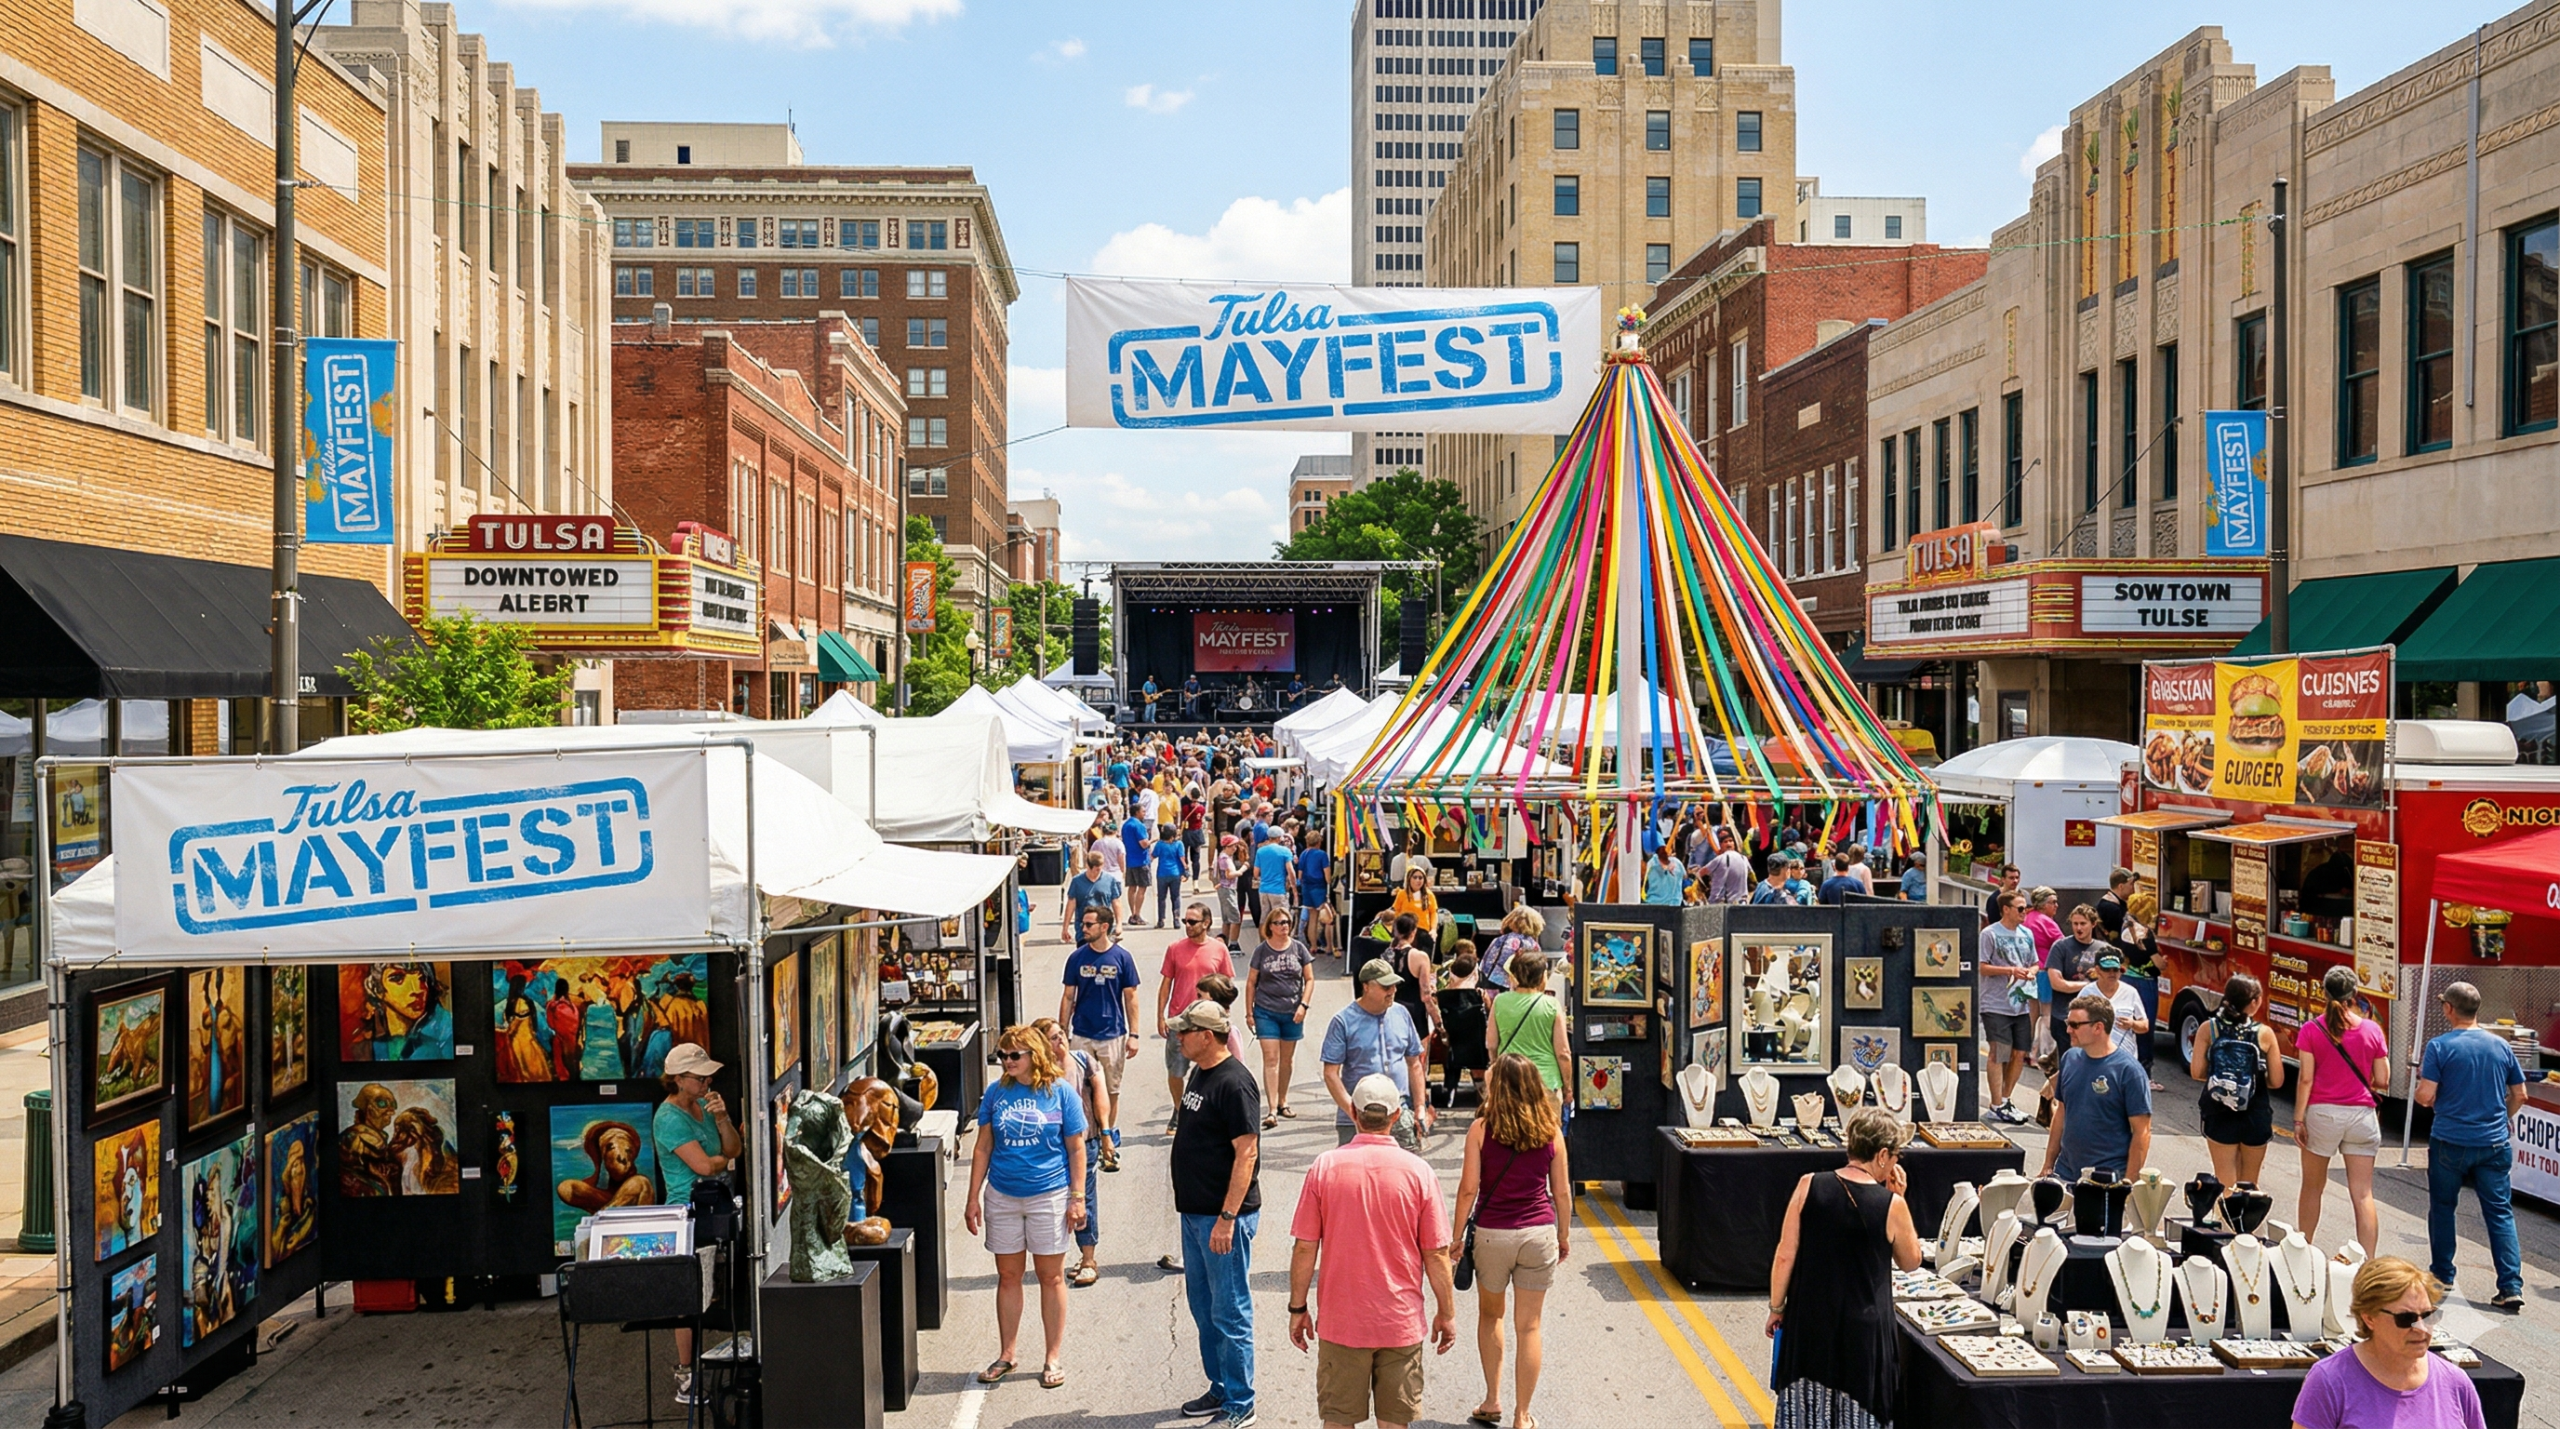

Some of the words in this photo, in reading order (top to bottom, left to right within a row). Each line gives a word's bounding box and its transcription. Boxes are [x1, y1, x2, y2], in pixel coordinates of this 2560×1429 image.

[1204, 290, 1336, 341] Tulsa
[1131, 321, 1542, 412] MAYFEST
[331, 364, 373, 524] MAYFEST
[2222, 428, 2252, 542] MAYFEST
[477, 521, 606, 550] TULSA
[464, 566, 620, 588] DOWNTOWED
[1199, 631, 1290, 648] MAYFEST
[2137, 608, 2209, 627] TULSE
[2224, 759, 2284, 788] GURGER
[278, 778, 421, 835] Tulsa
[192, 800, 629, 914] MAYFEST
